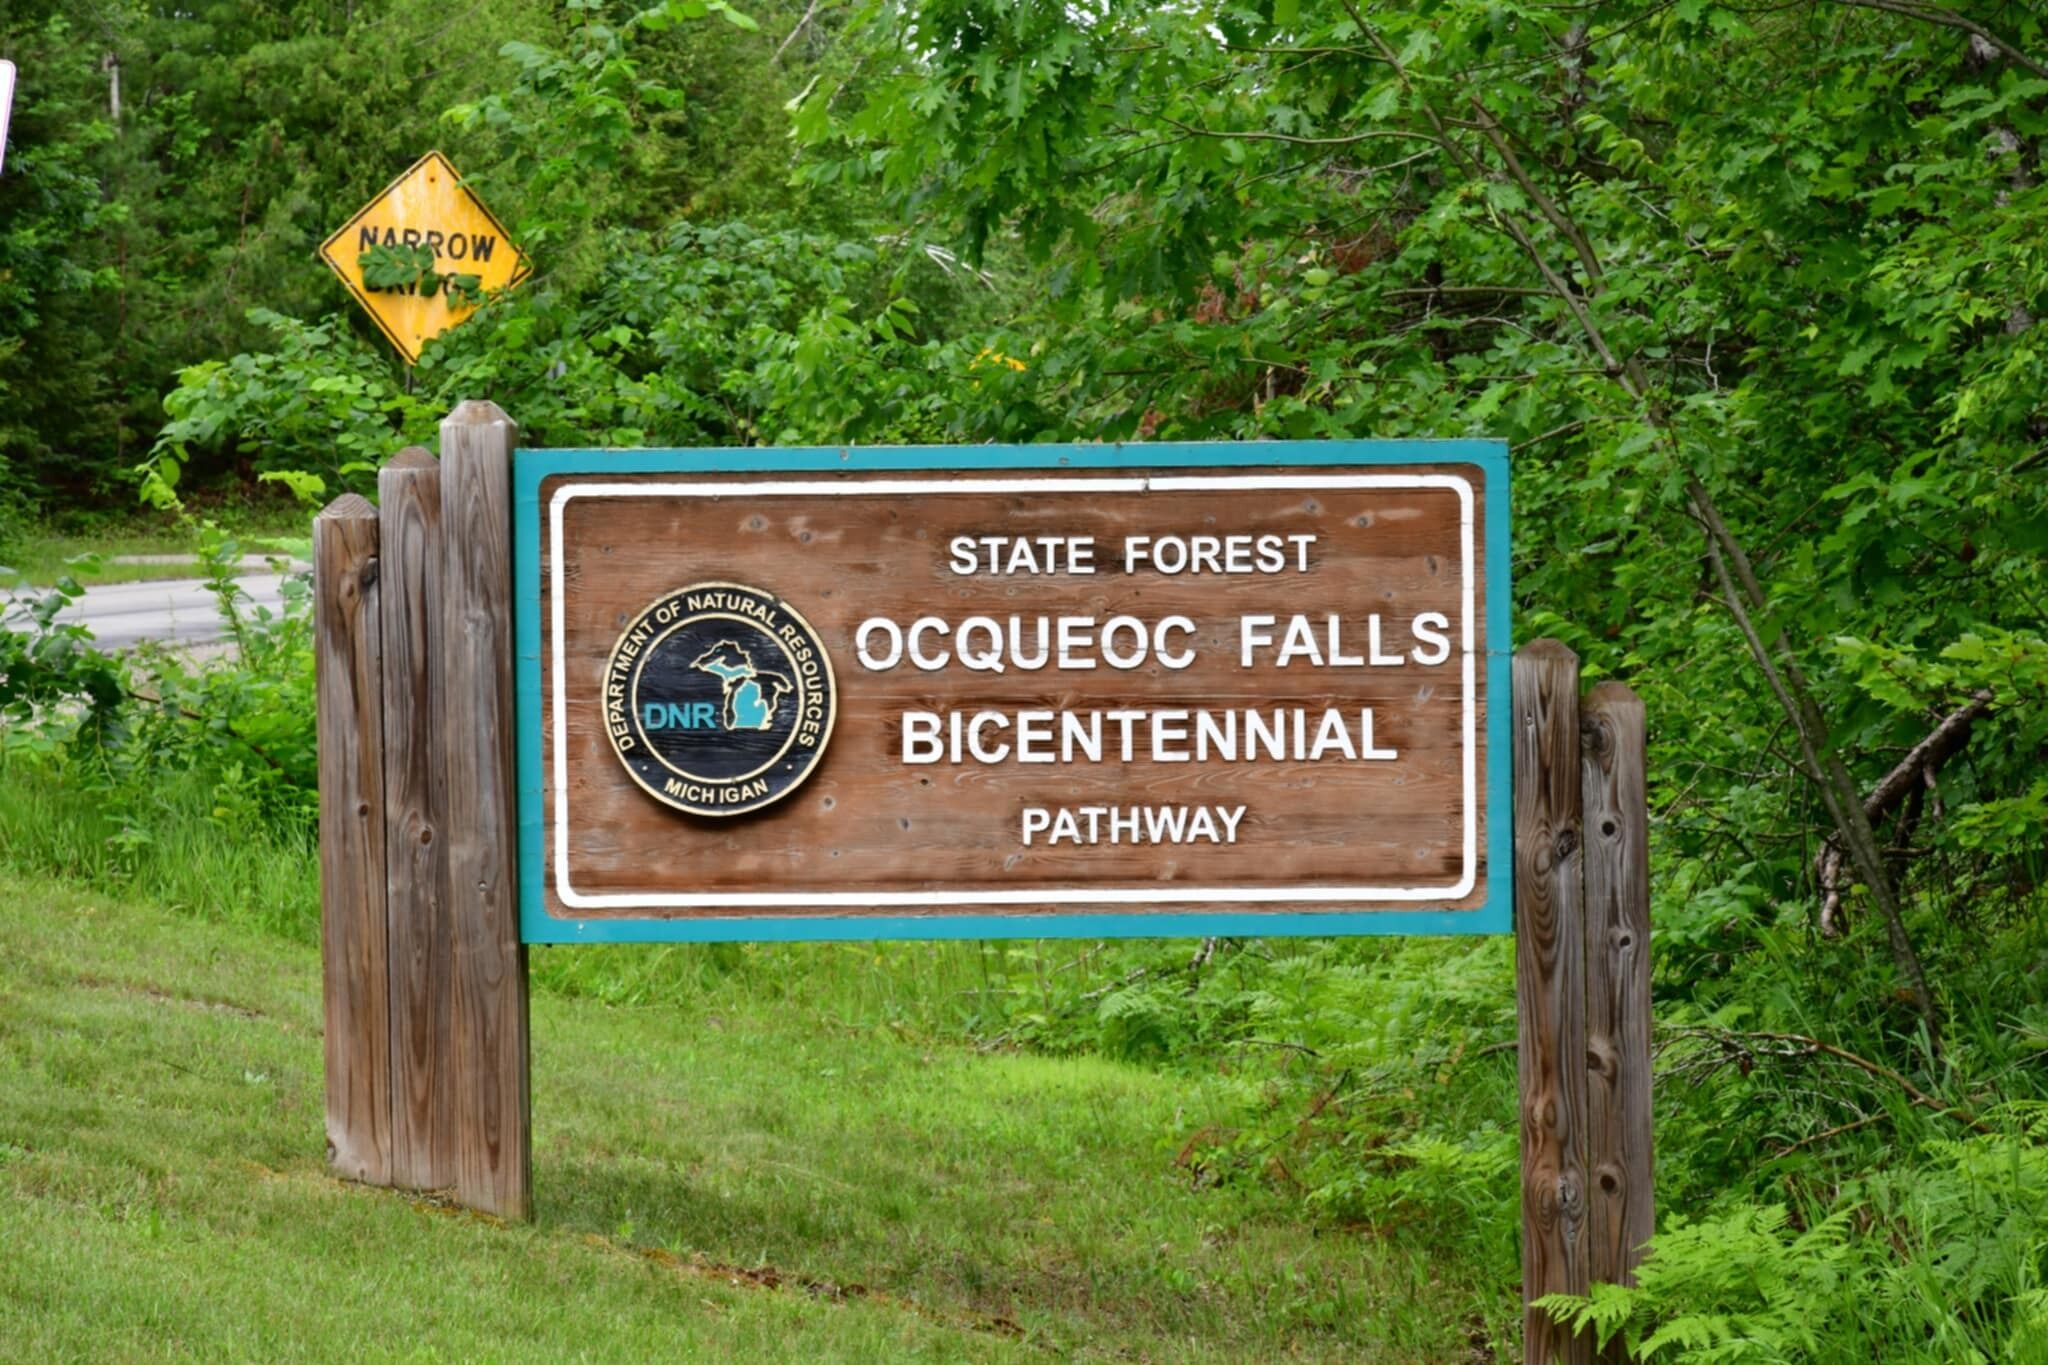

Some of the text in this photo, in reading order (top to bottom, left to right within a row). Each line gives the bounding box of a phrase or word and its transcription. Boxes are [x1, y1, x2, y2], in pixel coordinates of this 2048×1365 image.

[359, 225, 496, 263] NARROW
[949, 534, 1317, 575] STATE FOREST
[855, 612, 1451, 673] OCQUEOC FALLS
[608, 592, 823, 751] DEPARTMENT OF NATURAL RESOURCES
[643, 703, 717, 730] DNR
[901, 707, 1398, 764] BICENTENNIAL
[664, 777, 769, 804] MICHIGAN
[1022, 805, 1247, 846] PATHWAY
